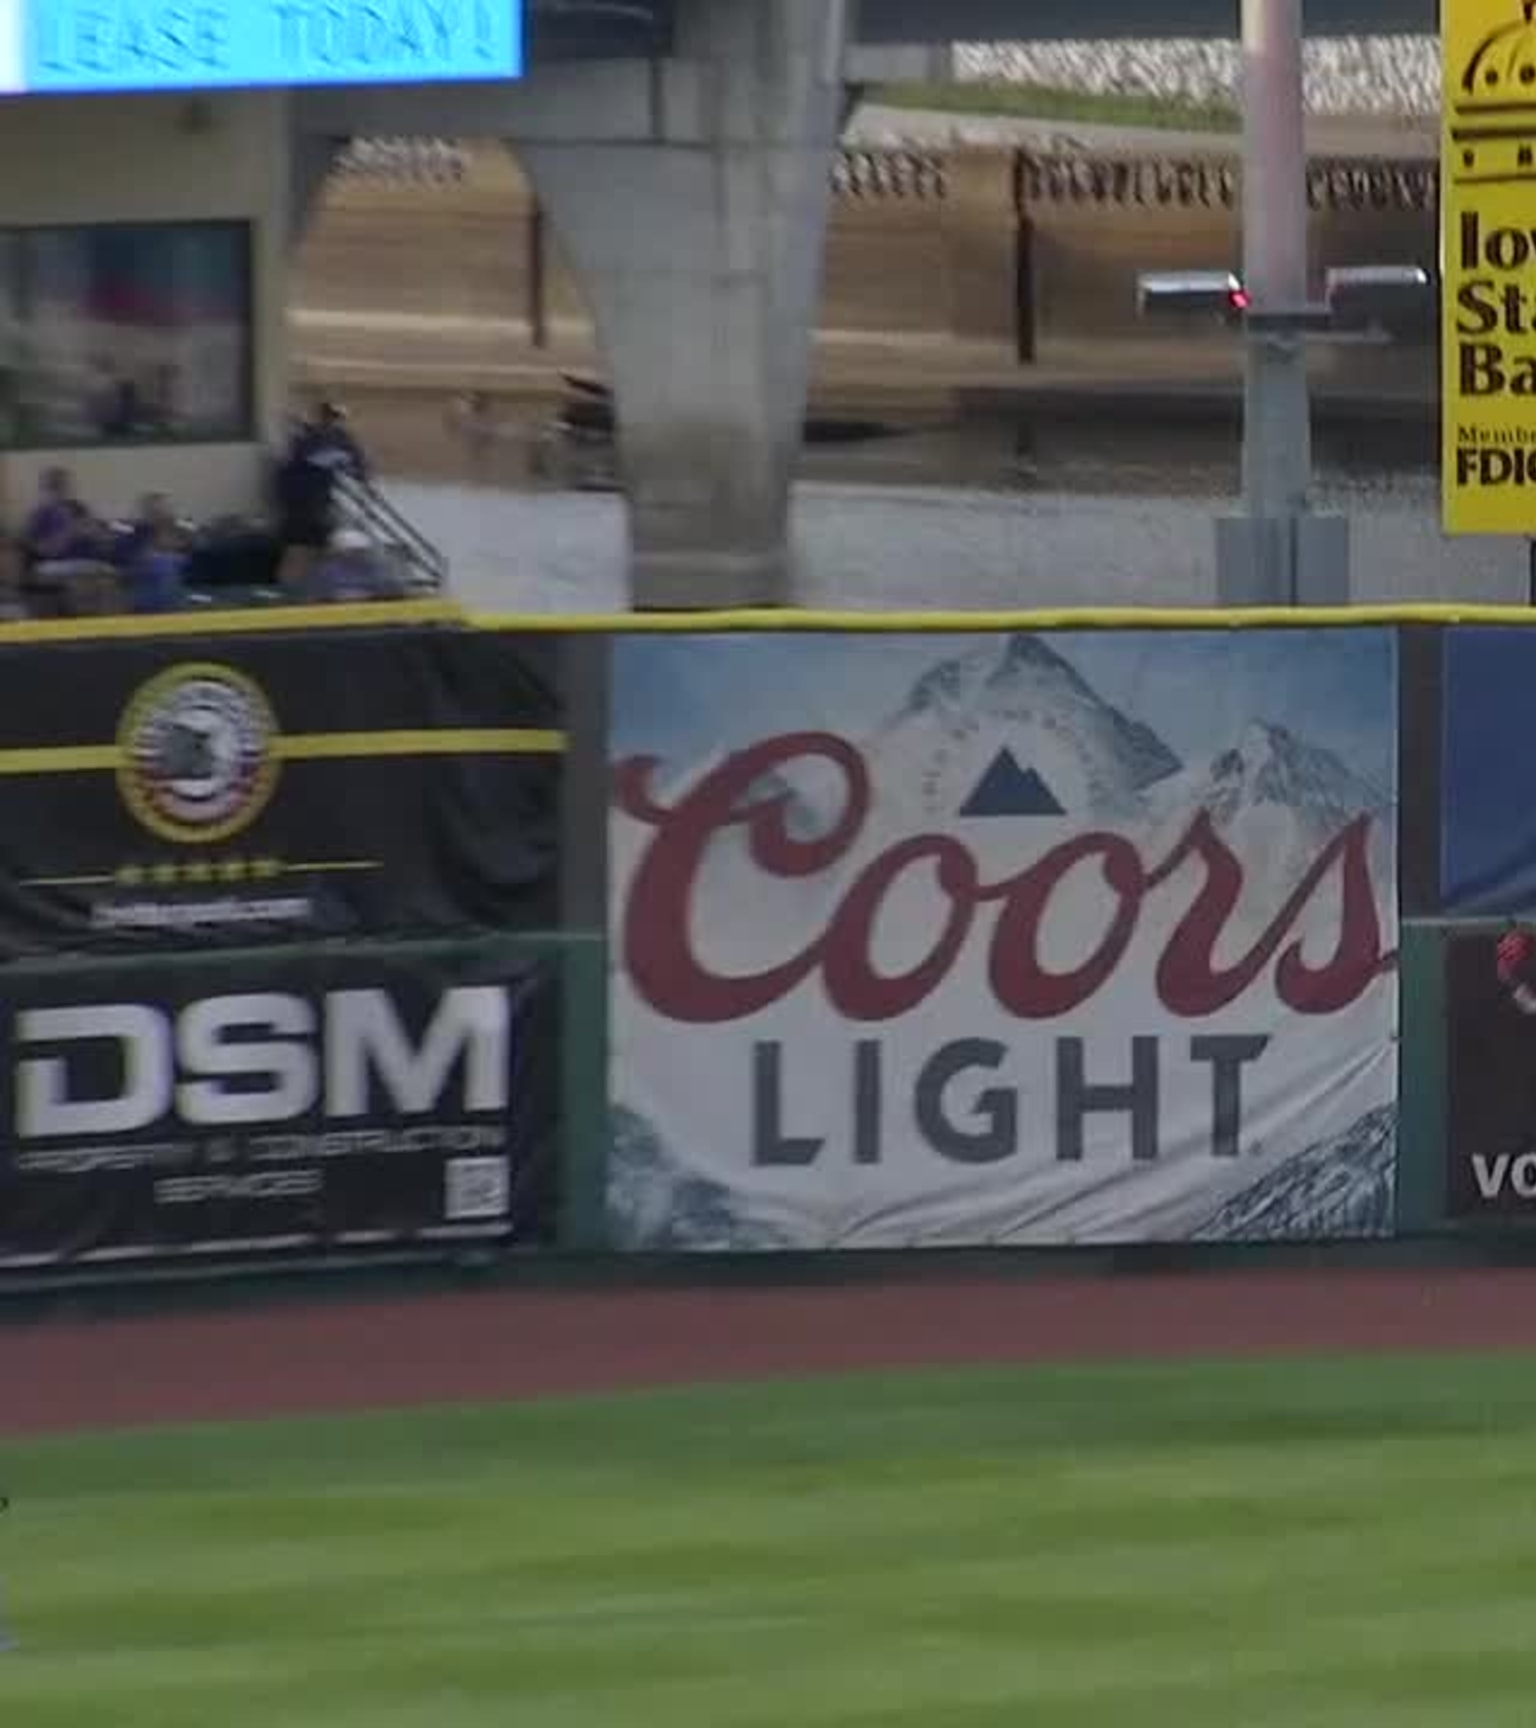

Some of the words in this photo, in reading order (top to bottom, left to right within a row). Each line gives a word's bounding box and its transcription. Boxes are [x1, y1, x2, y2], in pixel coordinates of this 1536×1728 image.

[614, 730, 1399, 1024] Coors
[15, 984, 511, 1139] DSM
[750, 1032, 1271, 1165] LIGHT
